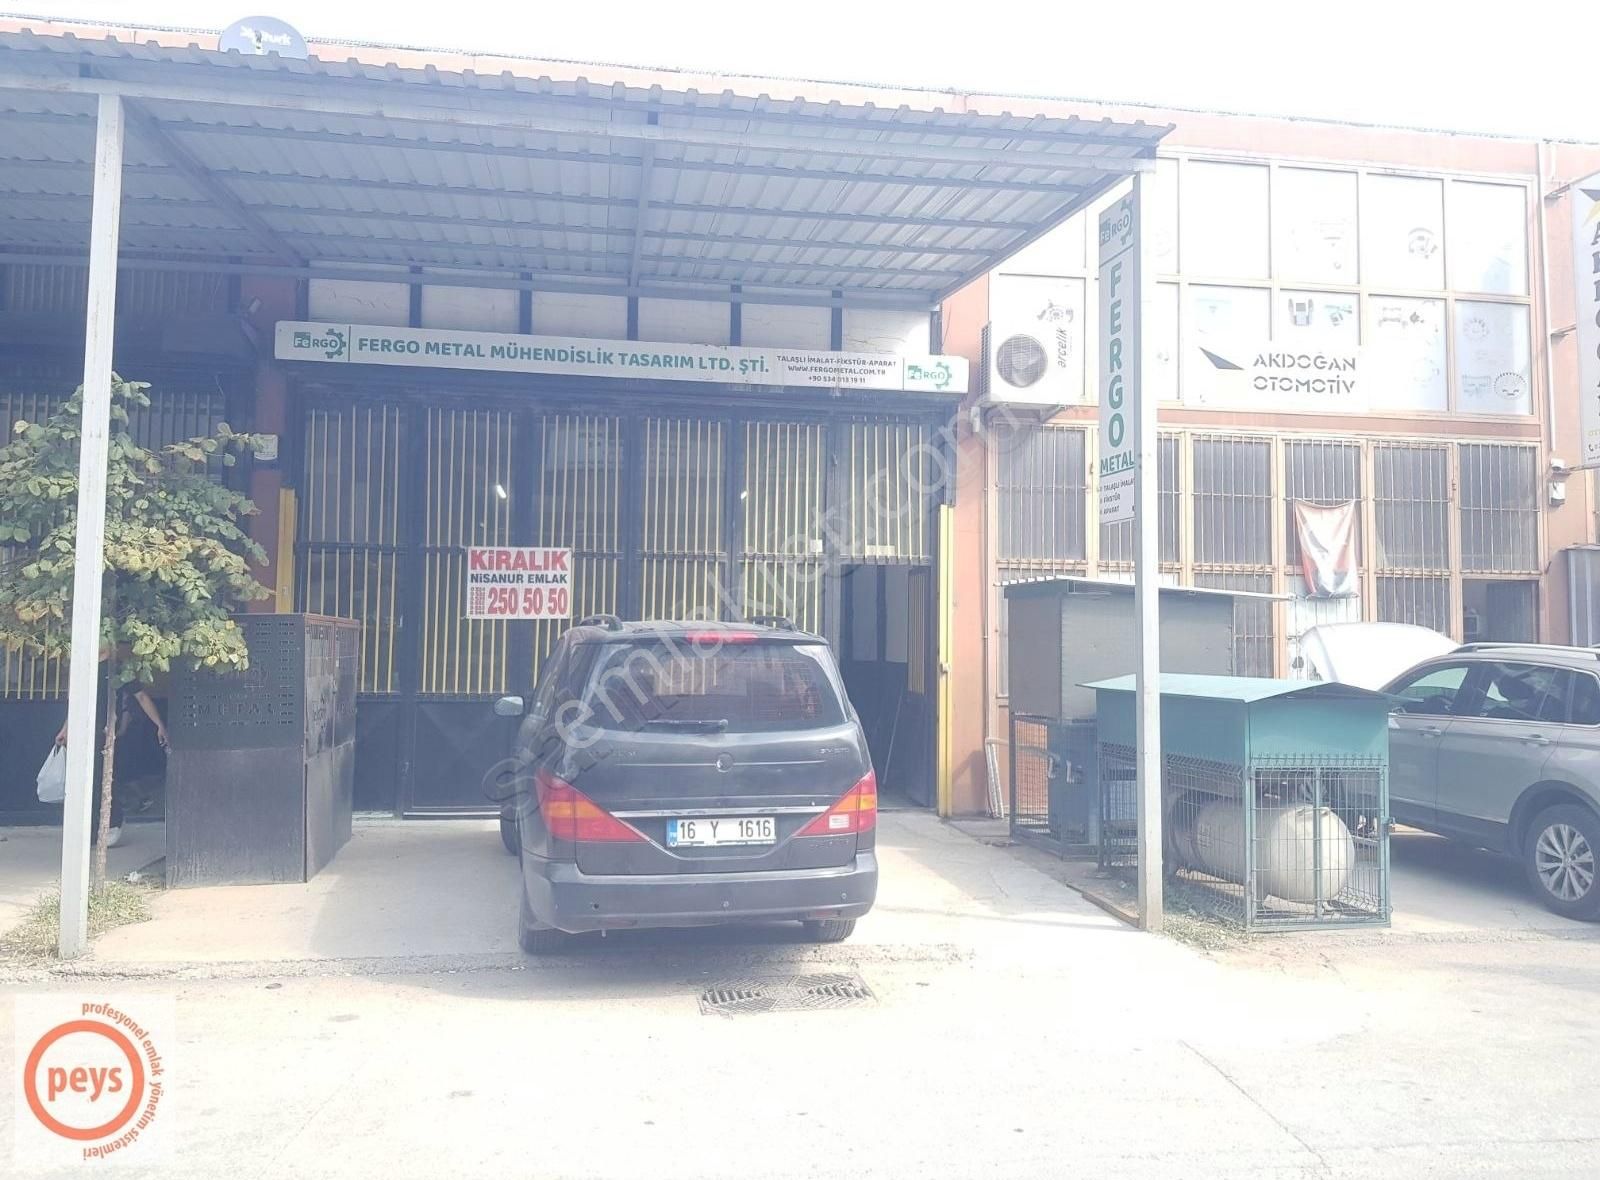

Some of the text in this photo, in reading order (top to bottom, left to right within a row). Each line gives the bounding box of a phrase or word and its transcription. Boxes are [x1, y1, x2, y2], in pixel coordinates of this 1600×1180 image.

[358, 337, 420, 354] FERGO
[425, 341, 485, 358] METAL
[491, 344, 614, 365] MÜHENDİSLİK
[618, 352, 694, 369] TASARIM
[699, 357, 735, 371] LTD.
[1110, 262, 1124, 448] FERGO
[1254, 375, 1356, 395] OTOMOTİV
[1100, 450, 1135, 474] METAL
[528, 573, 568, 584] EMLAK
[487, 587, 518, 615] 250
[522, 587, 544, 615] 50
[548, 587, 568, 615] 50
[681, 820, 771, 839] 16 Y 1616
